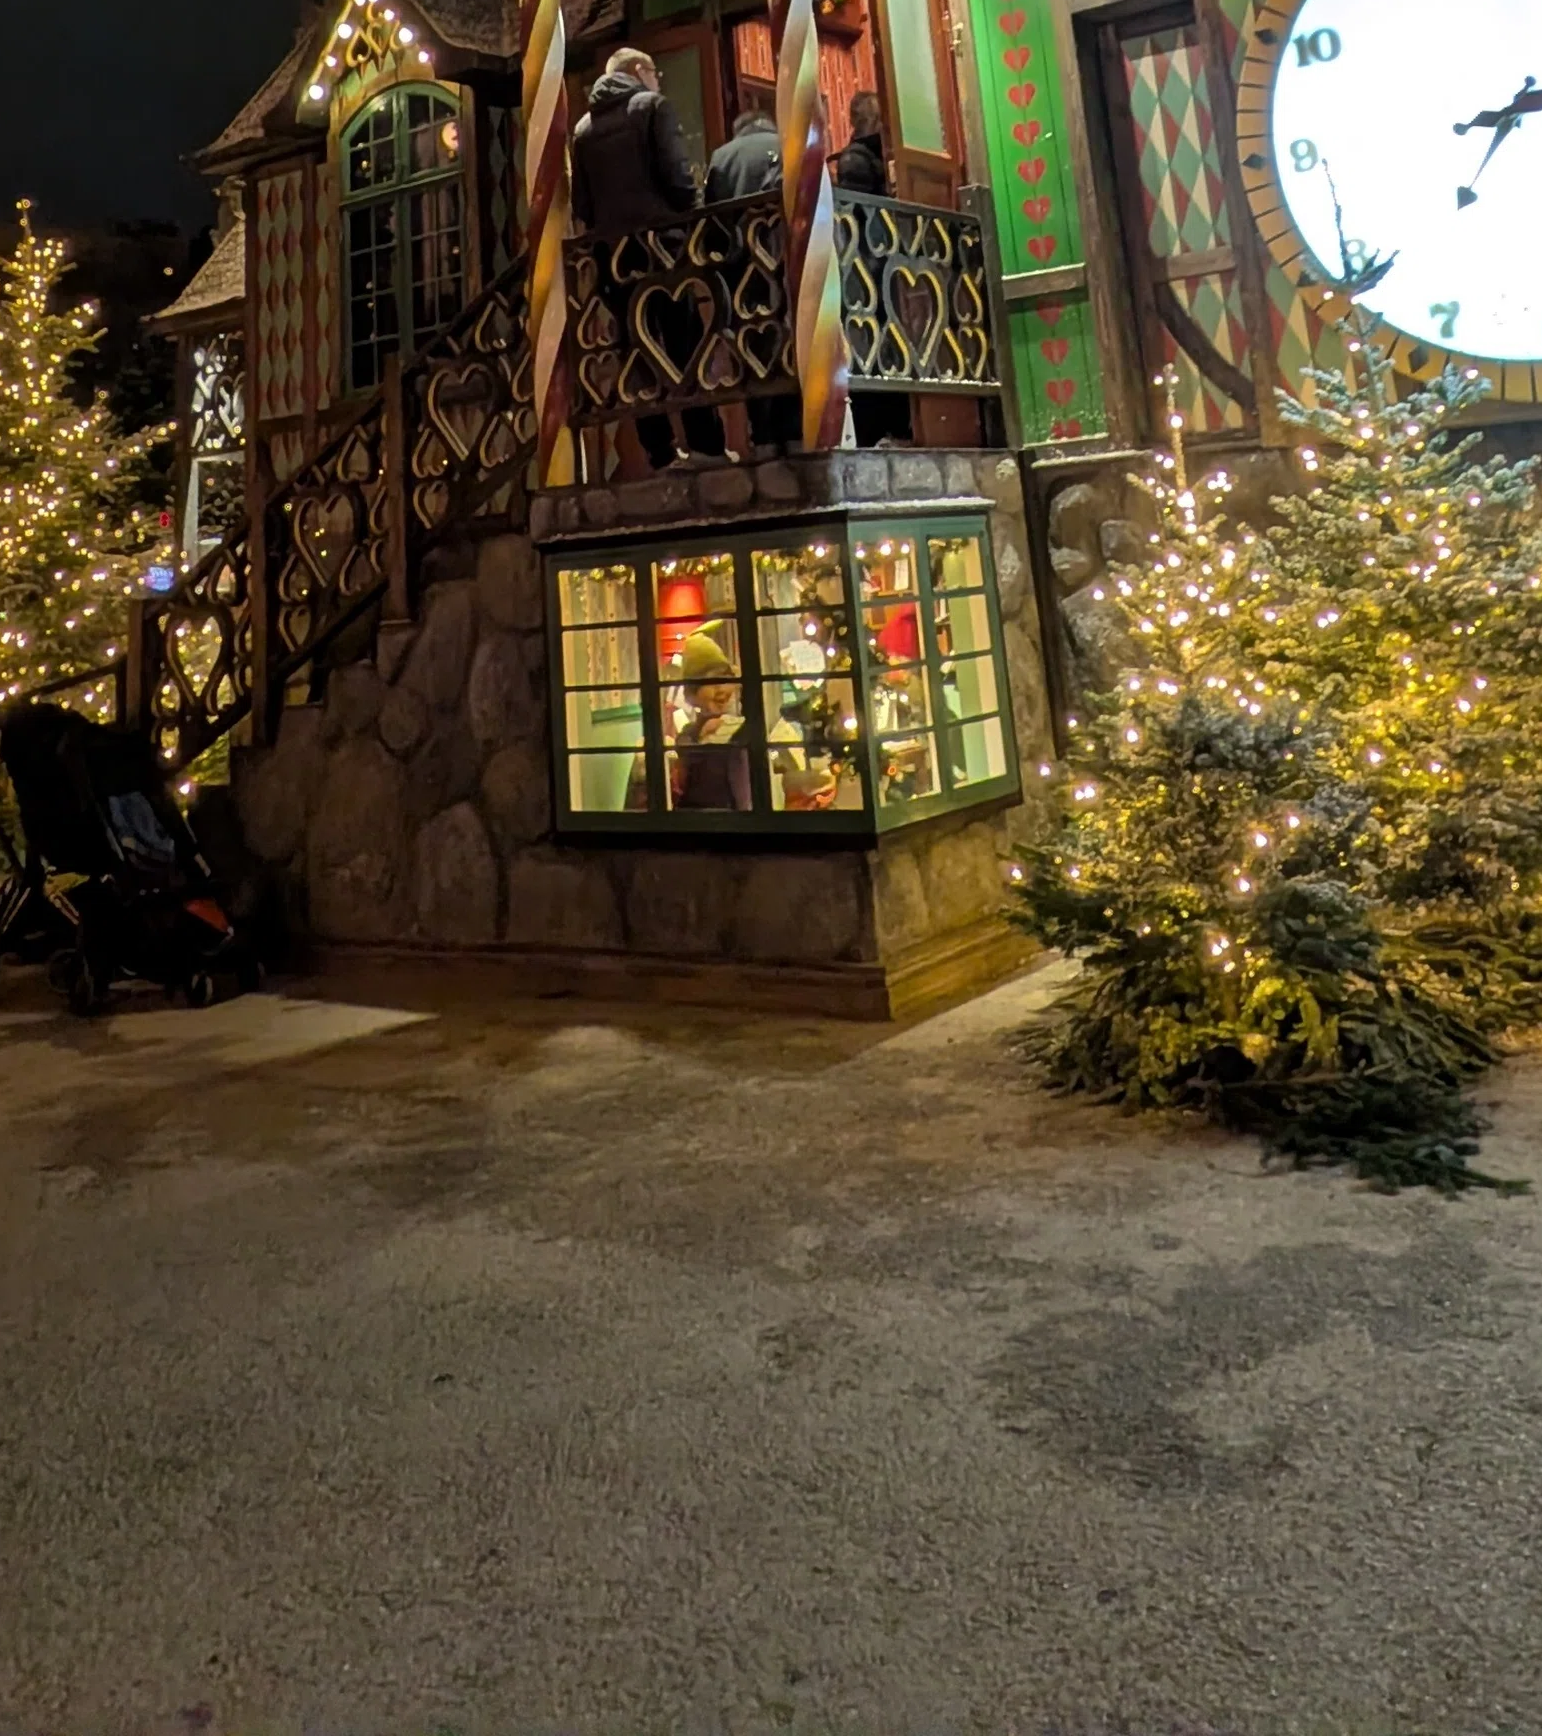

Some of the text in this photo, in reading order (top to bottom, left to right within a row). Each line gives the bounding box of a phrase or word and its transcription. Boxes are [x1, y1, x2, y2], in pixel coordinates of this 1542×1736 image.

[1293, 27, 1342, 68] 10
[1289, 139, 1319, 172] 9
[1429, 301, 1460, 339] 7
